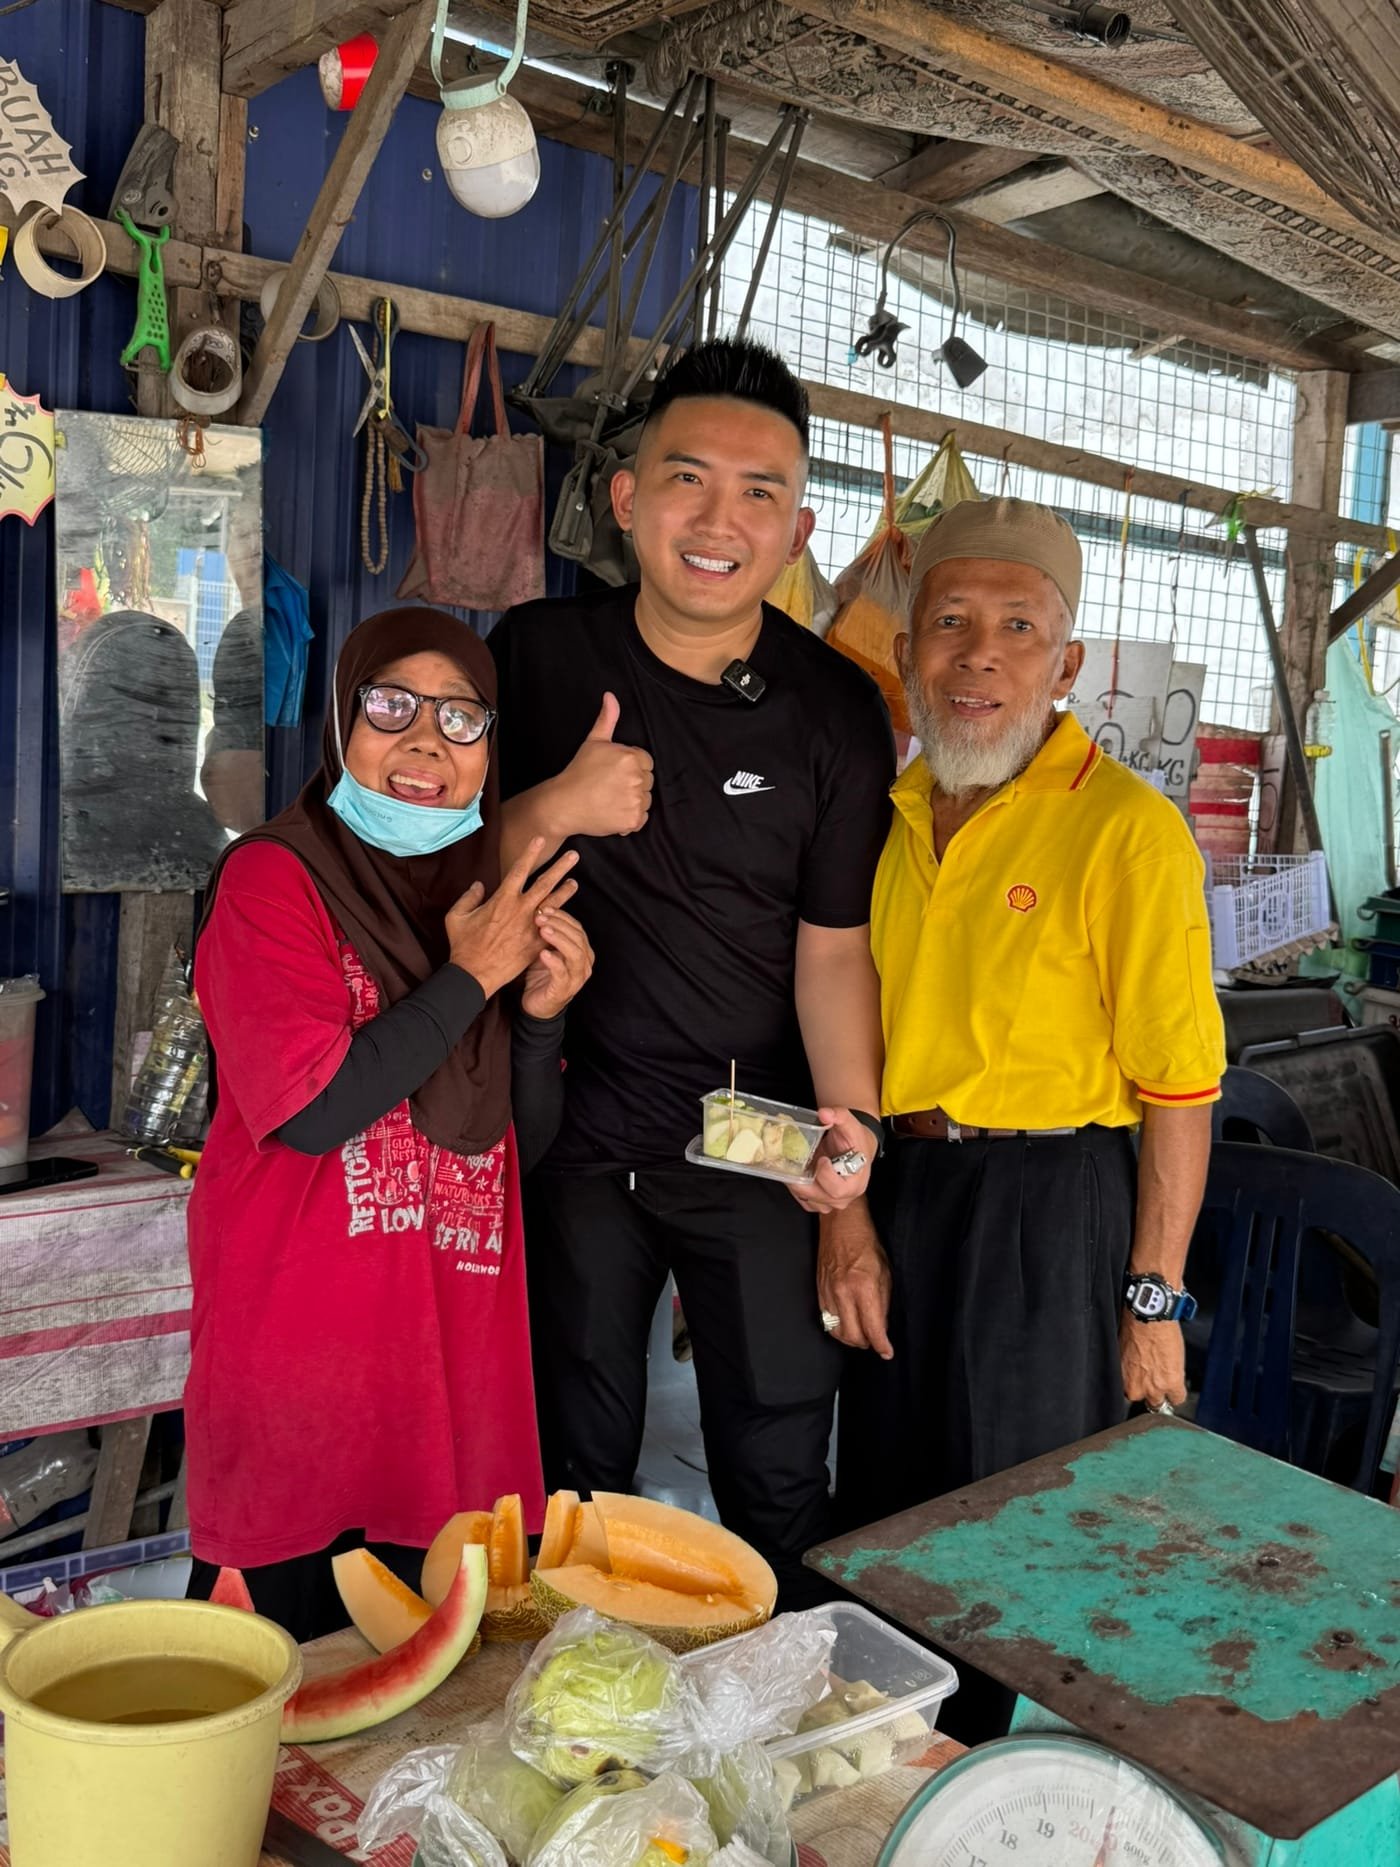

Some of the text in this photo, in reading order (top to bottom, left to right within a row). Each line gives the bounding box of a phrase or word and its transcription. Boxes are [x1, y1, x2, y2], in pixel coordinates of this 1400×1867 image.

[0, 65, 71, 176] BUAH
[731, 770, 765, 788] NIKE
[1035, 1818, 1056, 1839] 19
[999, 1829, 1018, 1850] 18
